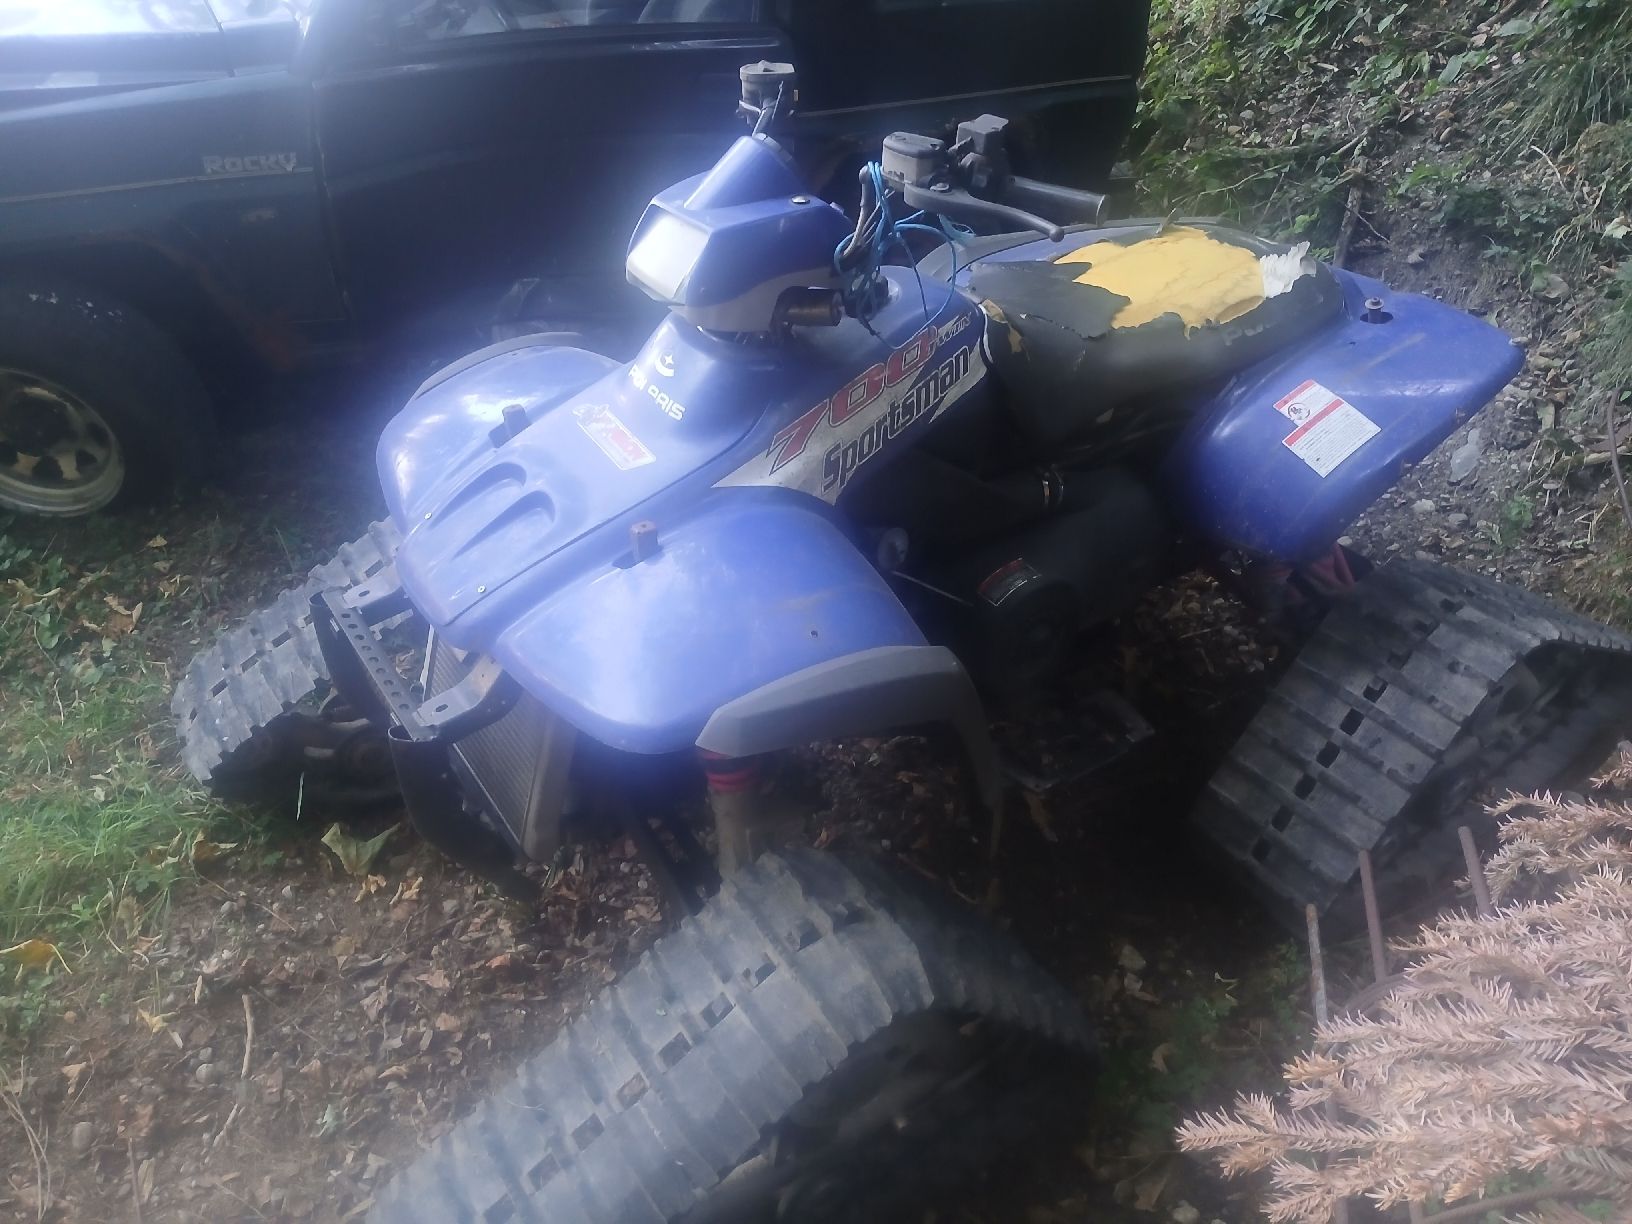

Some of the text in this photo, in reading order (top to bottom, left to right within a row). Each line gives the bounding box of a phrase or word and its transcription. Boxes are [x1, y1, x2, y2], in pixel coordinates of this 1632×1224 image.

[202, 152, 297, 175] ROCKY
[765, 325, 938, 476] 700
[821, 345, 970, 495] Sportsman
